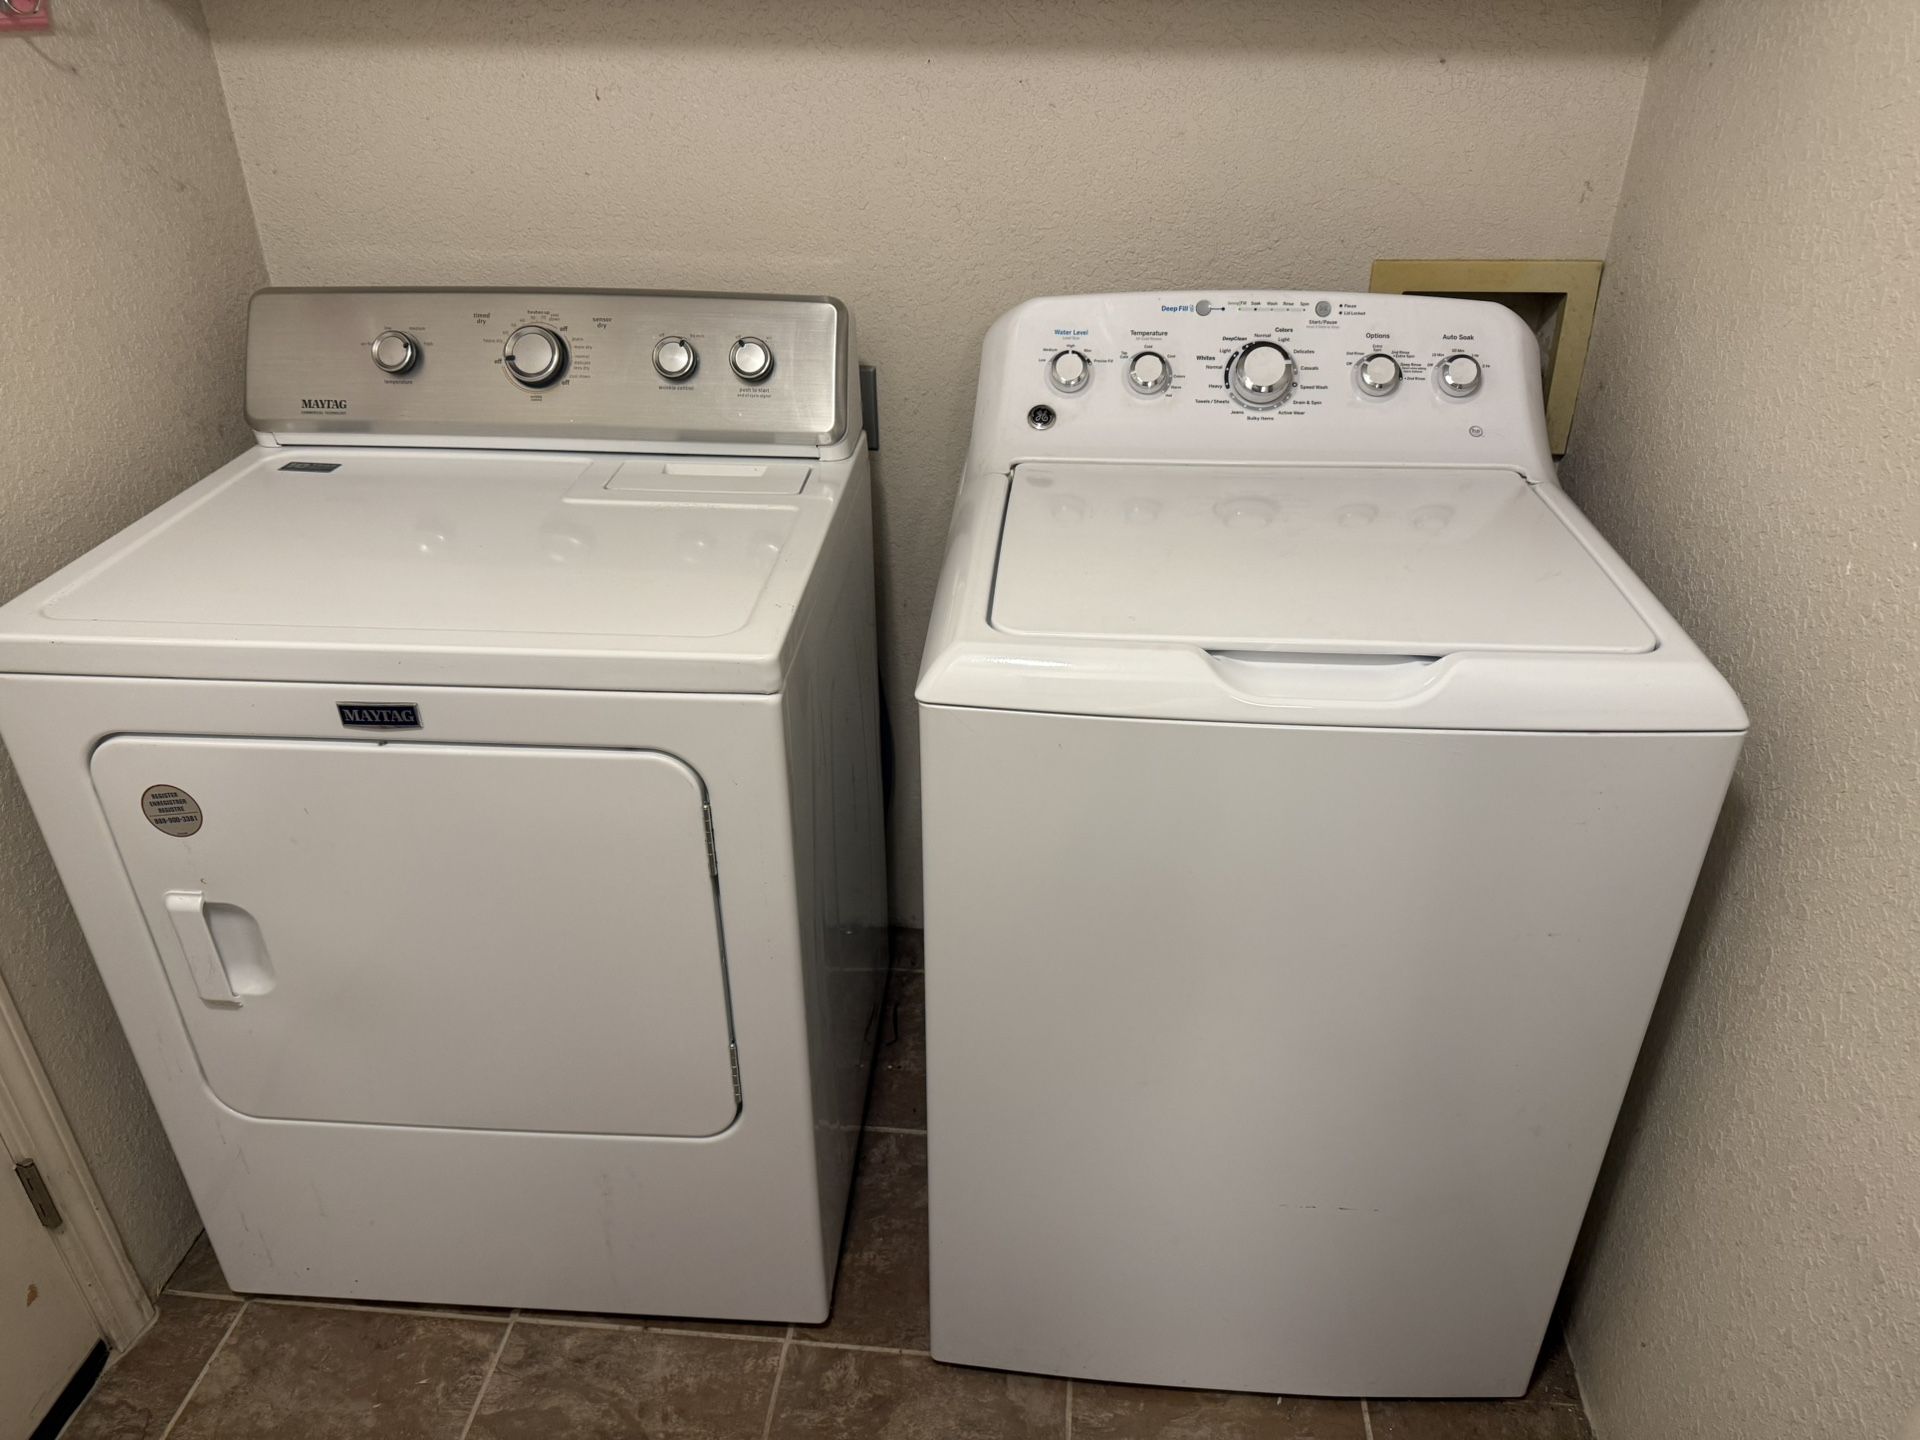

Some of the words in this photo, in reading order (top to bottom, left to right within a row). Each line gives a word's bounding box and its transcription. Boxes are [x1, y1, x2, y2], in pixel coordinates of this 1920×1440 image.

[1366, 332, 1390, 340] Options
[301, 399, 347, 409] MAYTAG
[342, 709, 414, 722] MAYTAG
[149, 799, 187, 807] ENREGISTRER
